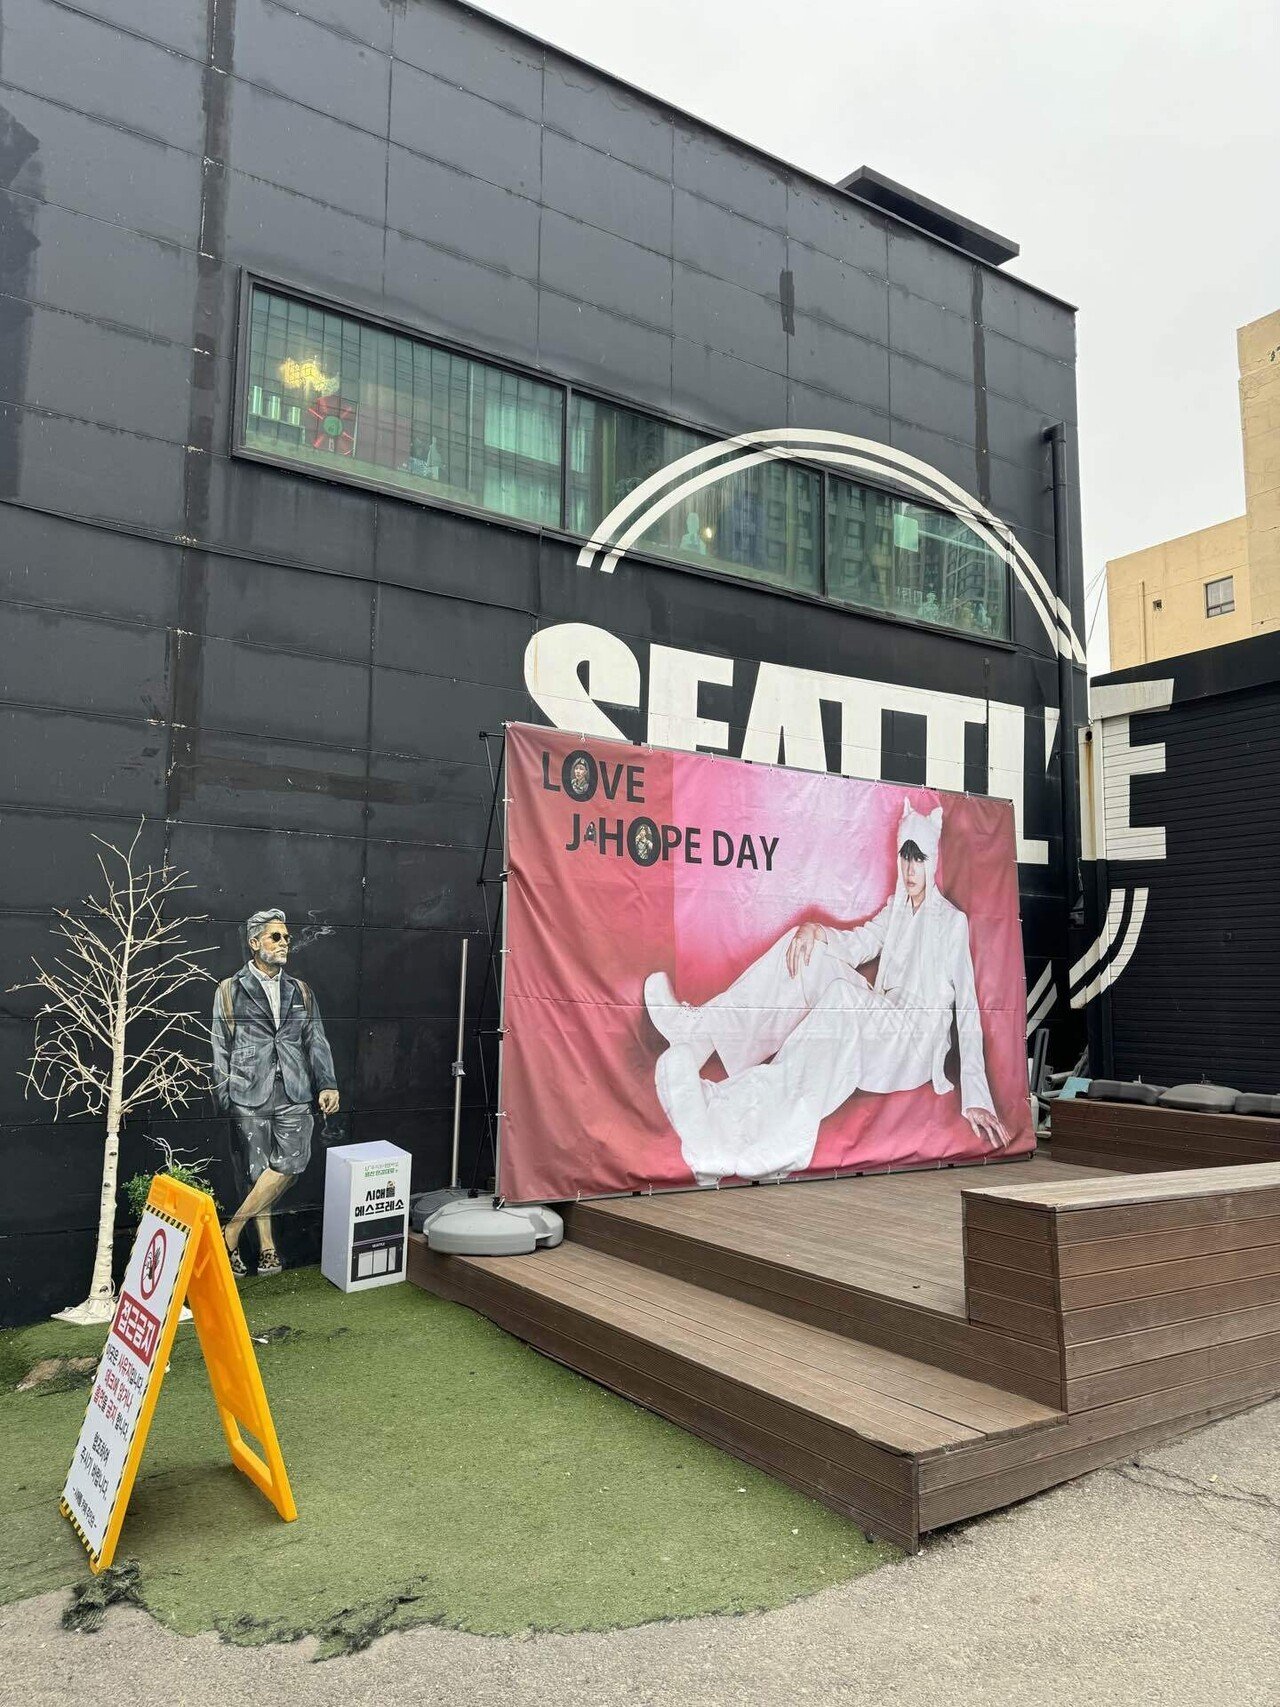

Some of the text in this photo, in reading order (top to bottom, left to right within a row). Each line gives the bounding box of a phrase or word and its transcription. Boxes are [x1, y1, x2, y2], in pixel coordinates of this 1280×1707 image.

[541, 749, 646, 804] LOVE
[713, 829, 780, 872] DAY
[354, 1198, 405, 1217] 에스프레소
[117, 1299, 156, 1358] 접근금지
[106, 1343, 119, 1366] 이곳은
[93, 1384, 109, 1413] 흡연을
[105, 1399, 118, 1426] 금지
[80, 1445, 94, 1476] 주시기
